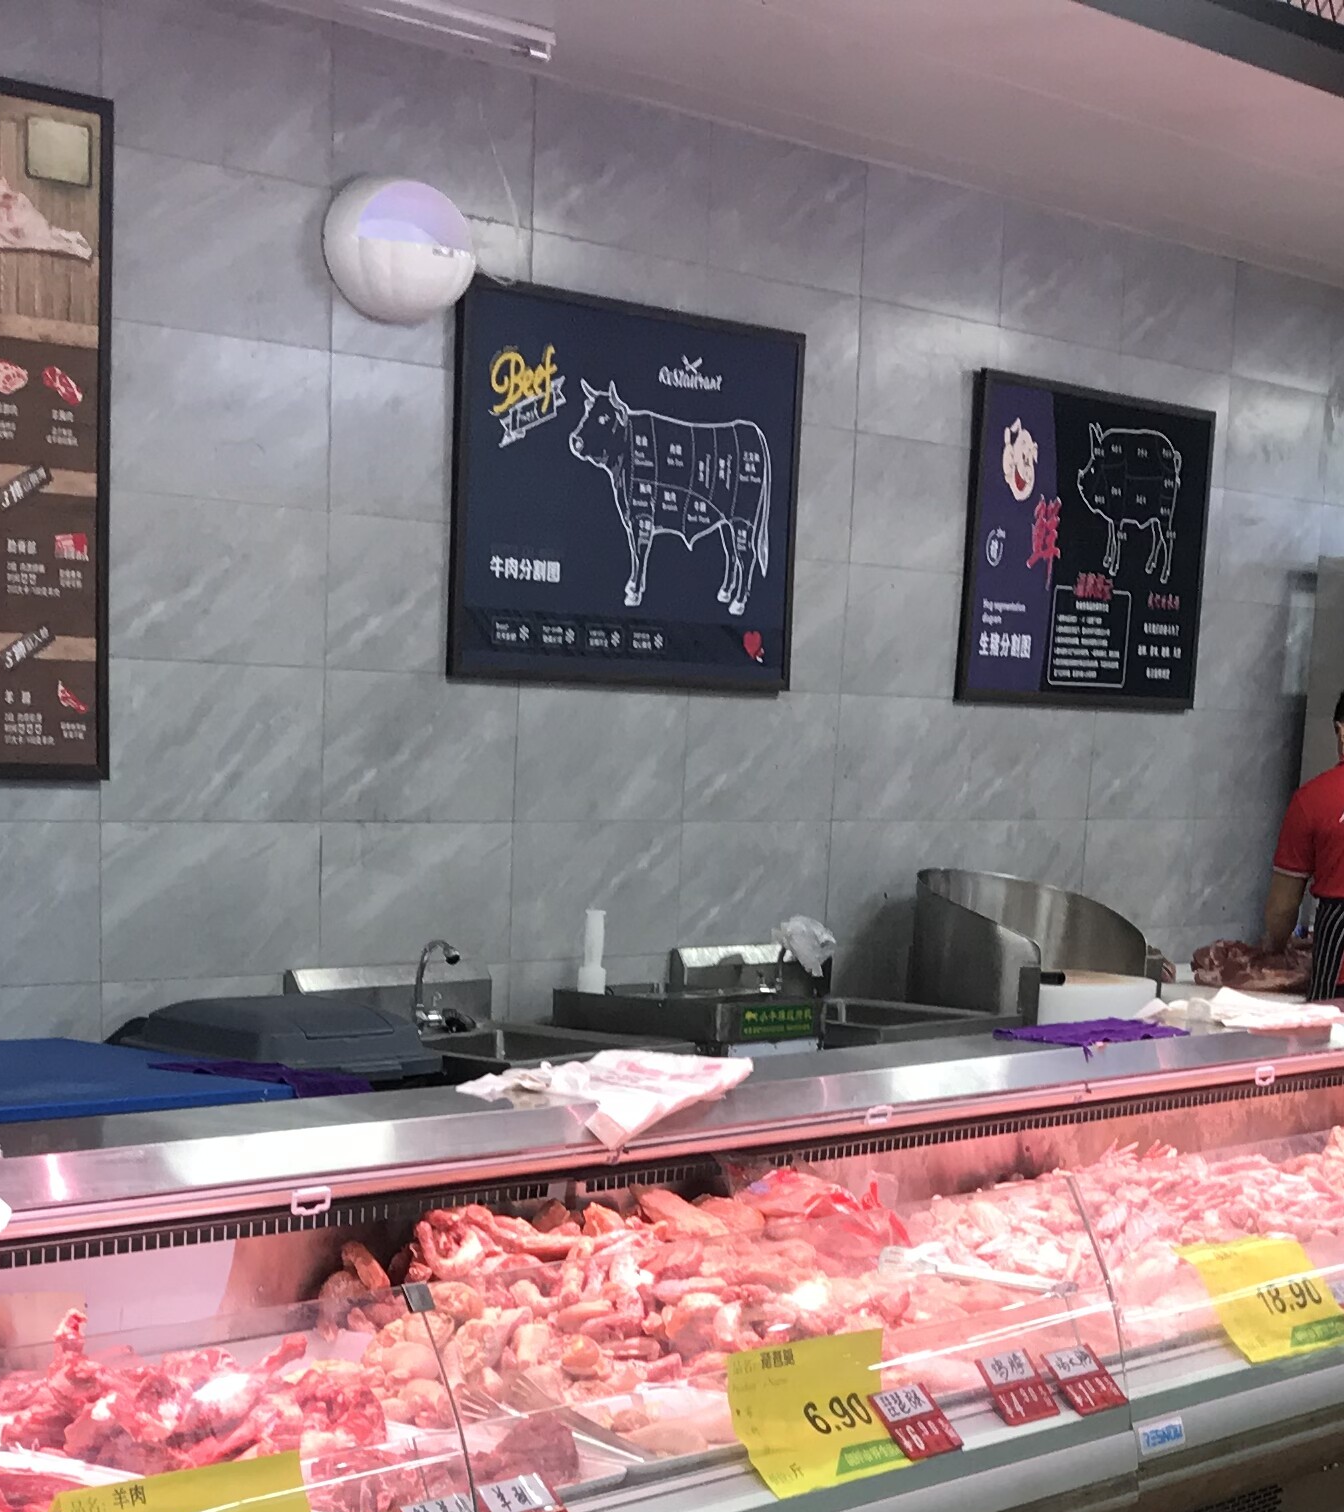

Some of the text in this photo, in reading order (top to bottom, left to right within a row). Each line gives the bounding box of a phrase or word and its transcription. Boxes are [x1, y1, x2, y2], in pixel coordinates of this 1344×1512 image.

[491, 344, 557, 414] Beef
[490, 555, 561, 583] 牛肉分割图
[1257, 1277, 1322, 1316] 18.90
[804, 1392, 873, 1435] 6.90
[112, 1484, 147, 1509] 羊肉
